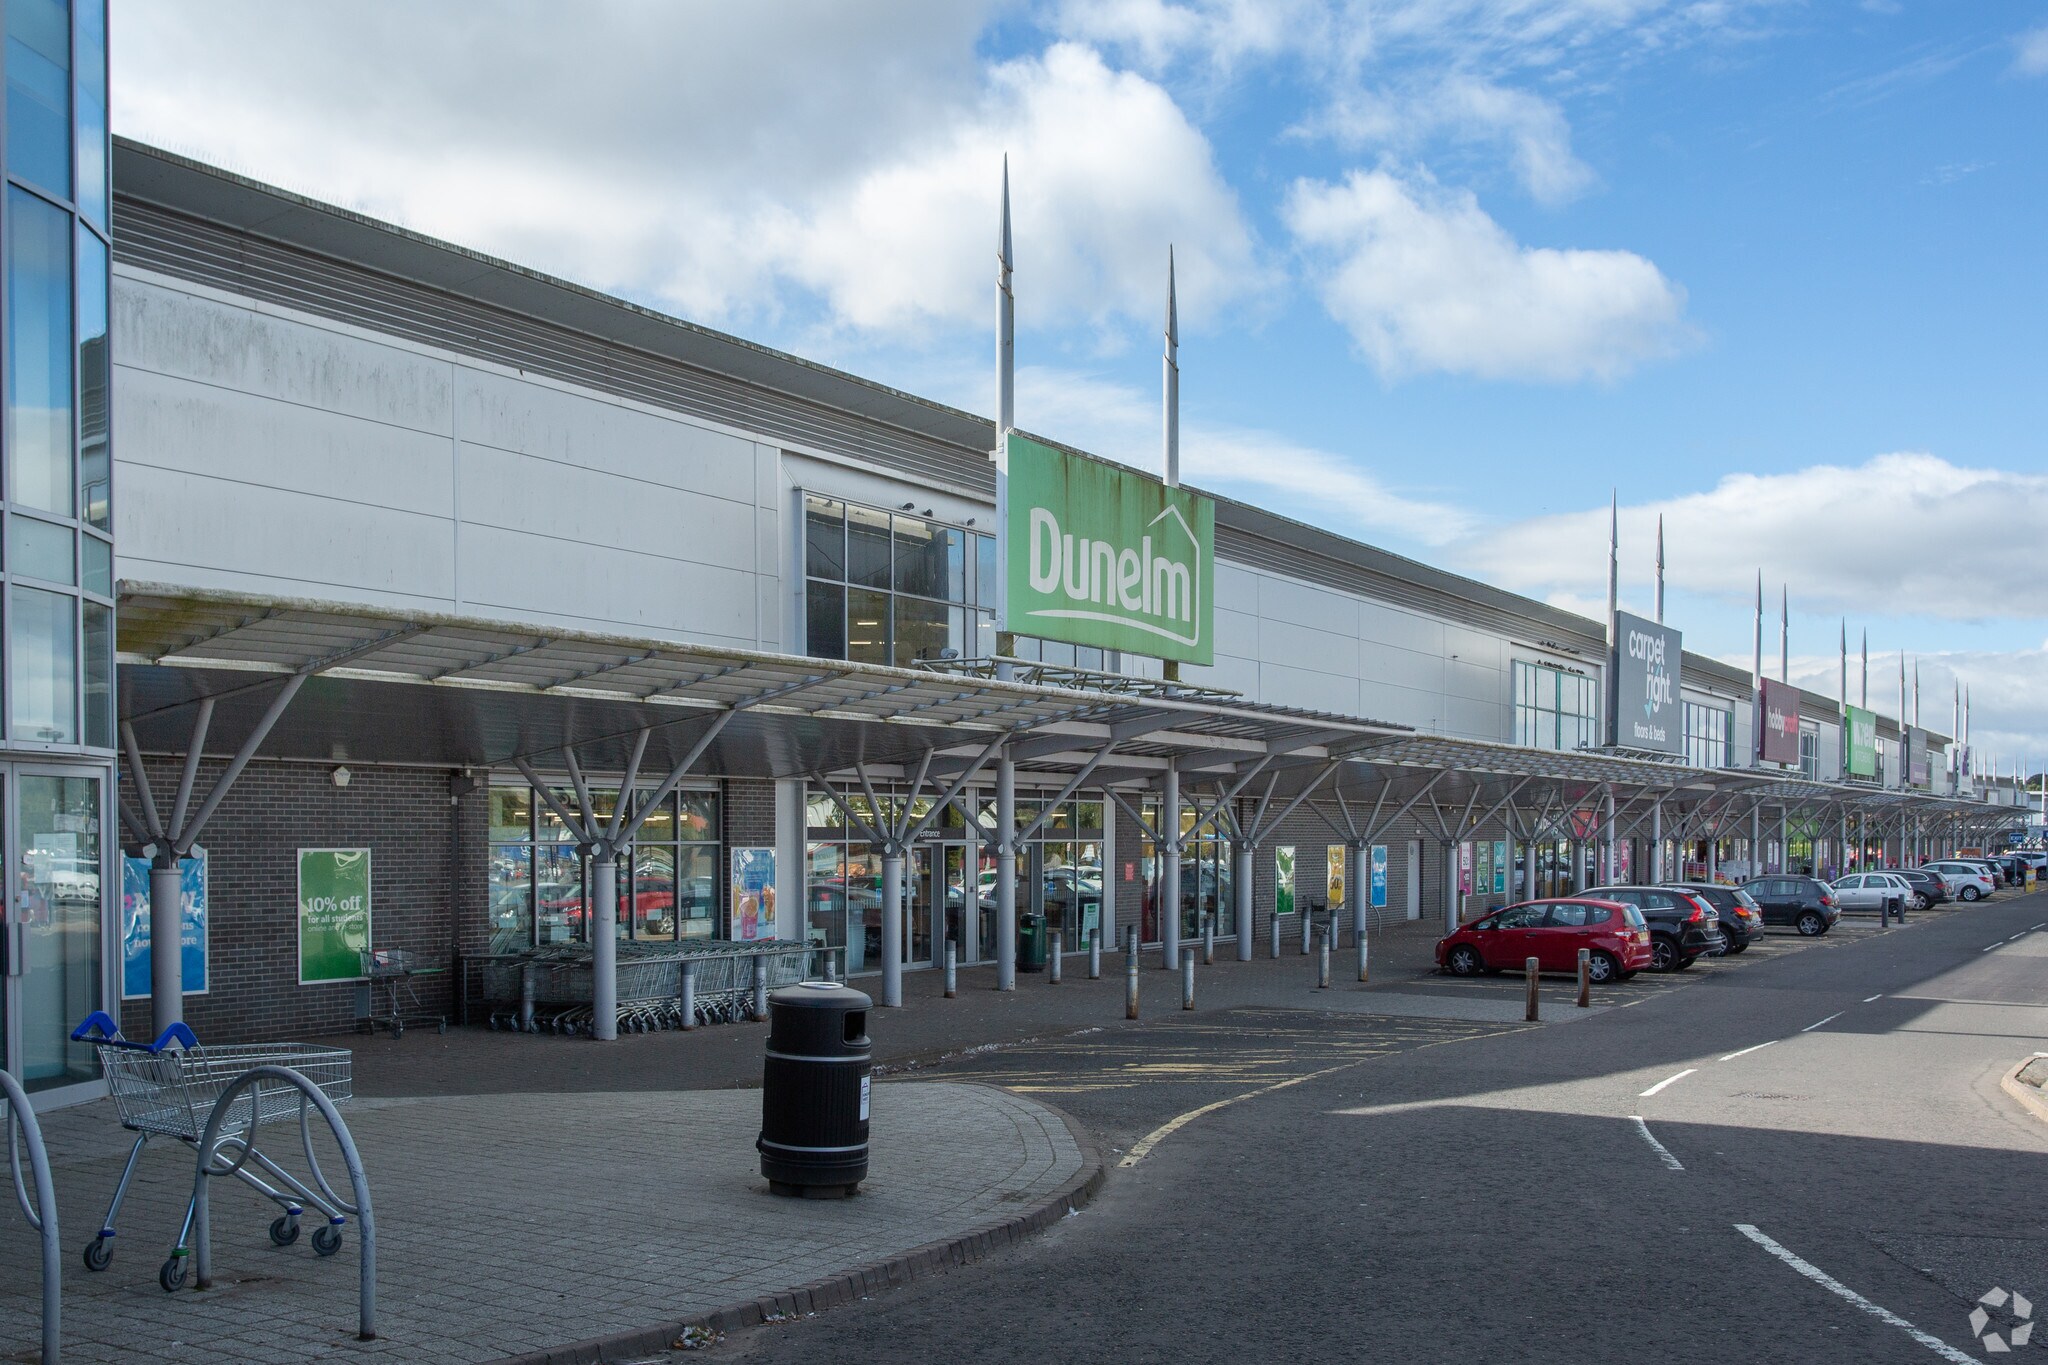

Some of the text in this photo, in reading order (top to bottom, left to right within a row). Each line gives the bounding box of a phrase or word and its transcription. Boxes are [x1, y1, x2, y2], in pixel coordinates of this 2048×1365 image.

[1030, 507, 1190, 622] Dunelm
[1629, 630, 1665, 672] carpet
[1646, 666, 1672, 713] right.
[1634, 722, 1666, 742] floors & beds
[920, 830, 940, 838] Entrance
[307, 896, 337, 912] 10%
[308, 914, 363, 924] for all students
